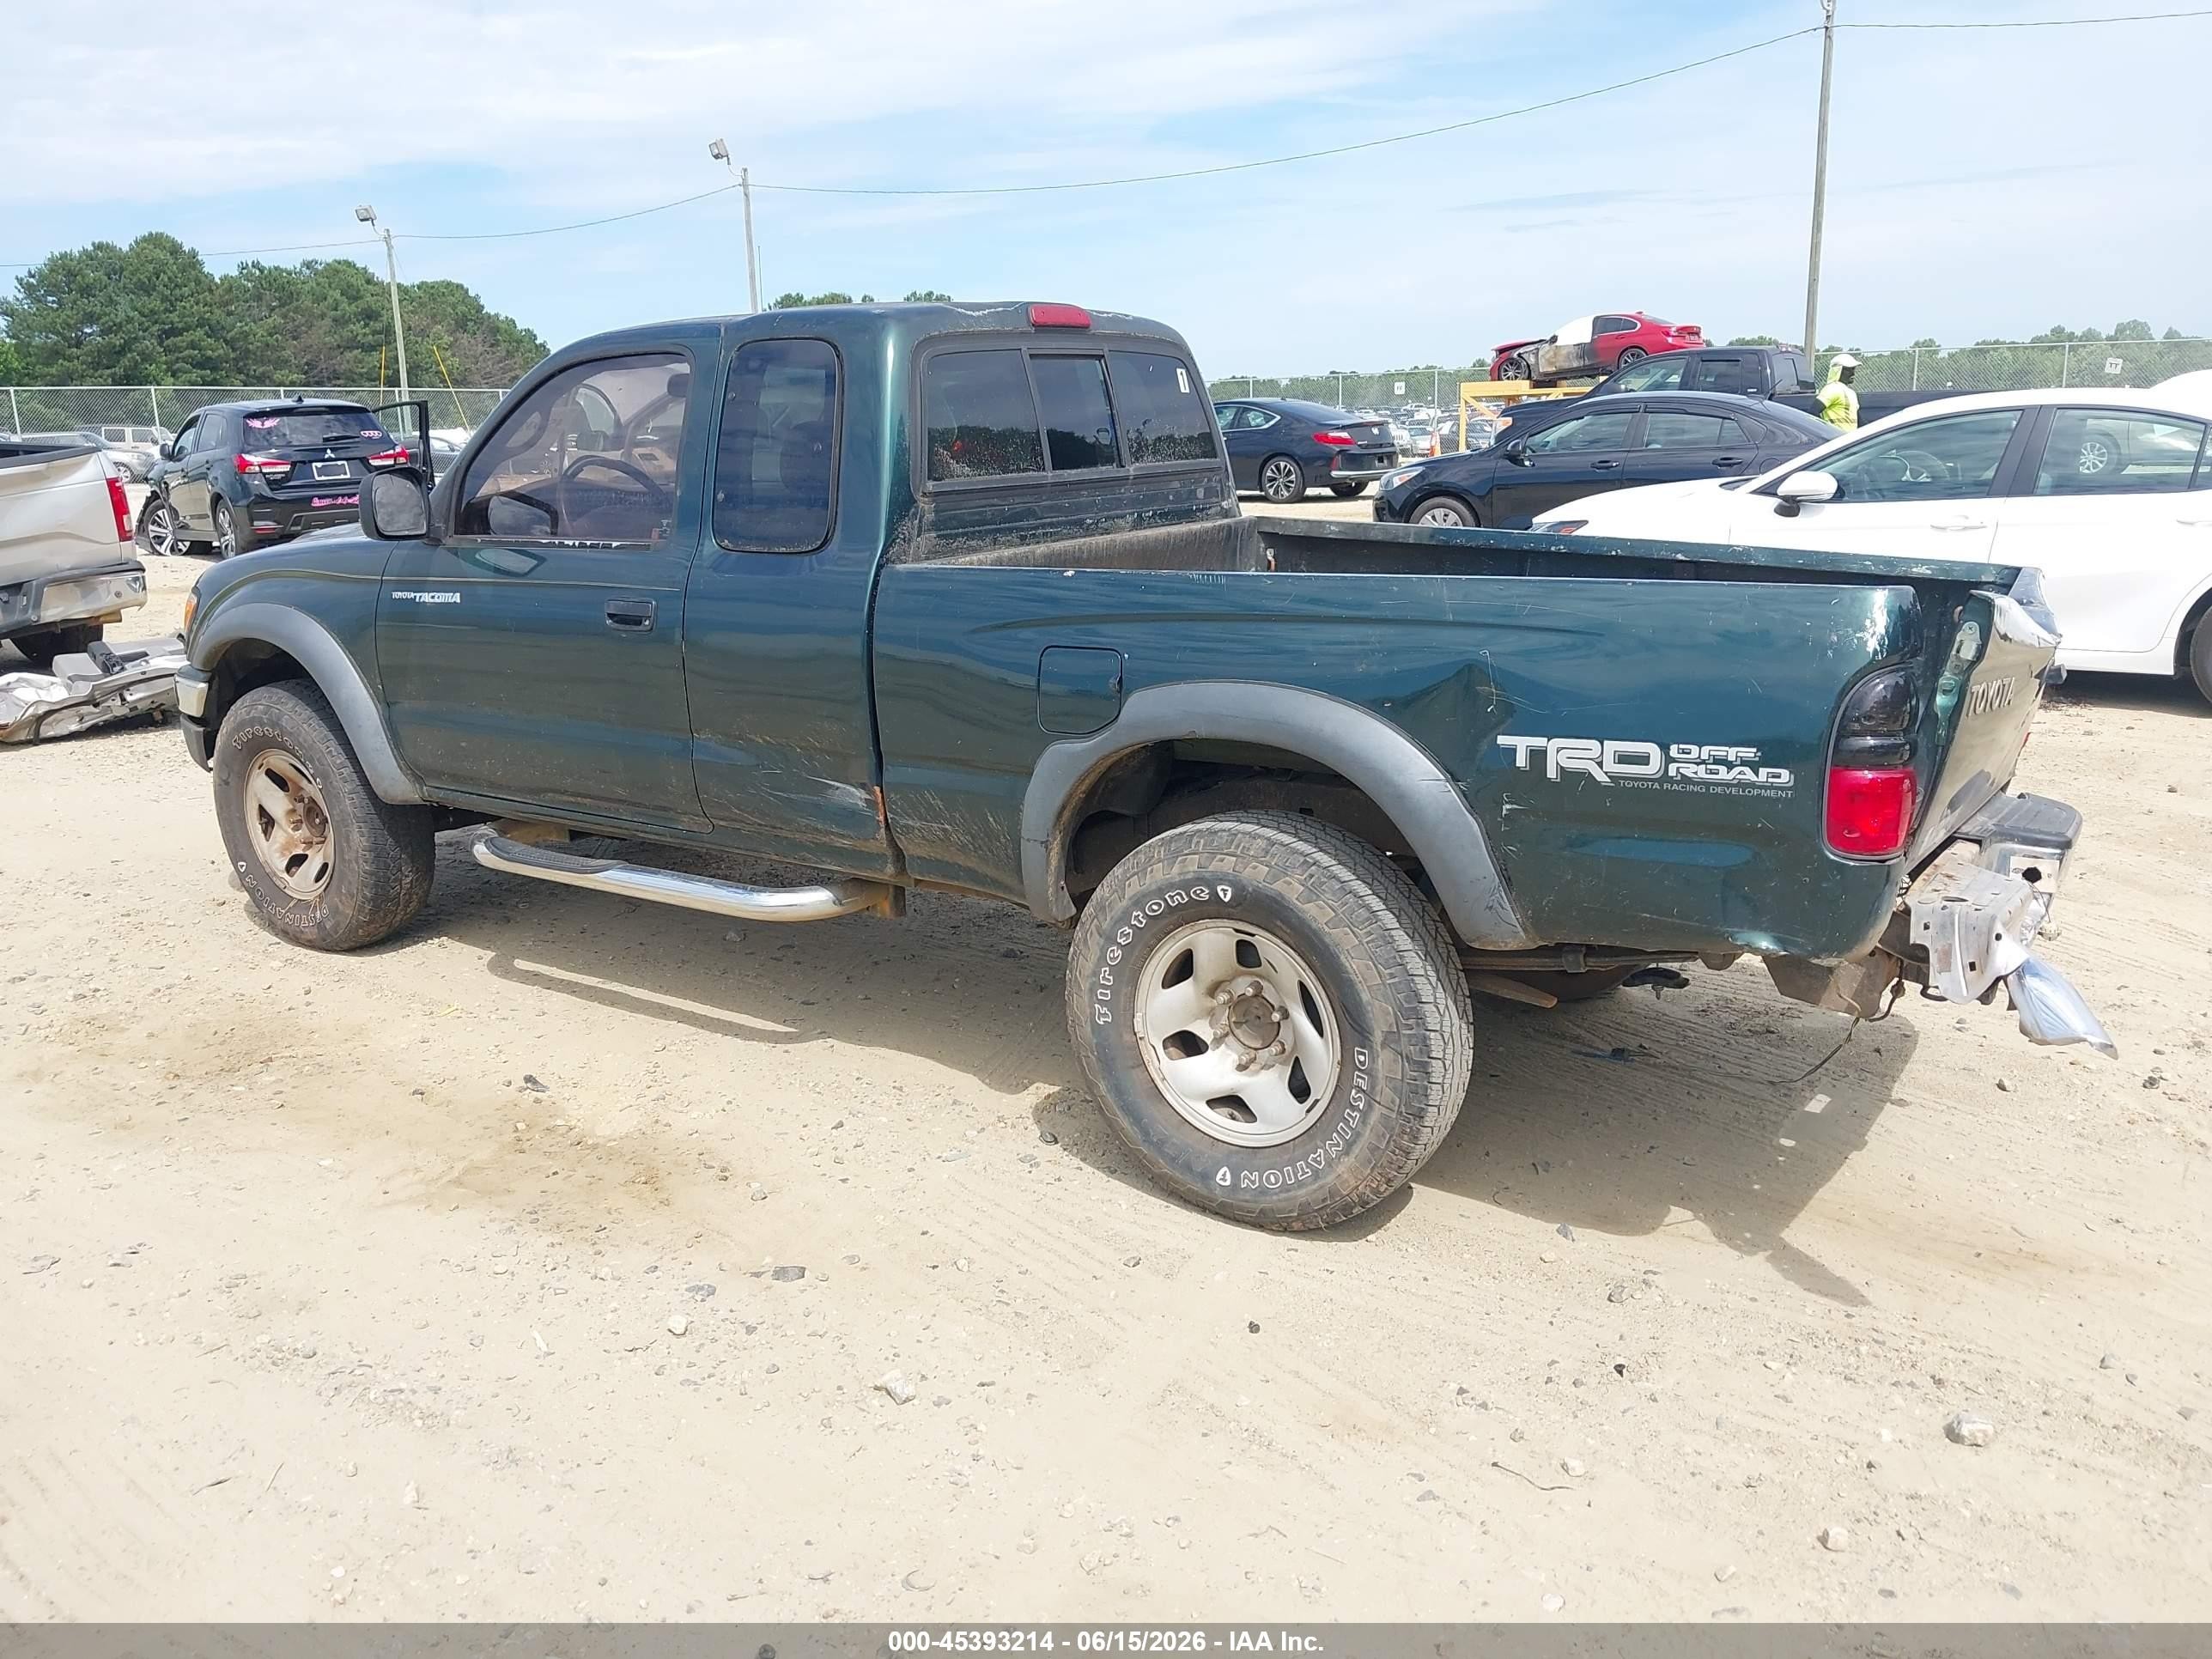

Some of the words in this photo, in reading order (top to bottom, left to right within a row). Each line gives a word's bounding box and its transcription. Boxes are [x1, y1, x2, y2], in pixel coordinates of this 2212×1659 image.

[413, 592, 461, 603] TACOMA
[1966, 677, 2015, 718] TOYOTA
[1497, 735, 1665, 787] TRD
[1669, 744, 1761, 764] OFF
[1619, 780, 1660, 790] TOYOTA
[1663, 782, 1705, 793] RACING
[1710, 786, 1795, 799] DEVELOPMENT
[1668, 763, 1795, 787] ROAD
[246, 874, 330, 927] DESTINATION
[1095, 886, 1210, 1024] Firestone
[1241, 1047, 1369, 1189] DESTINATION
